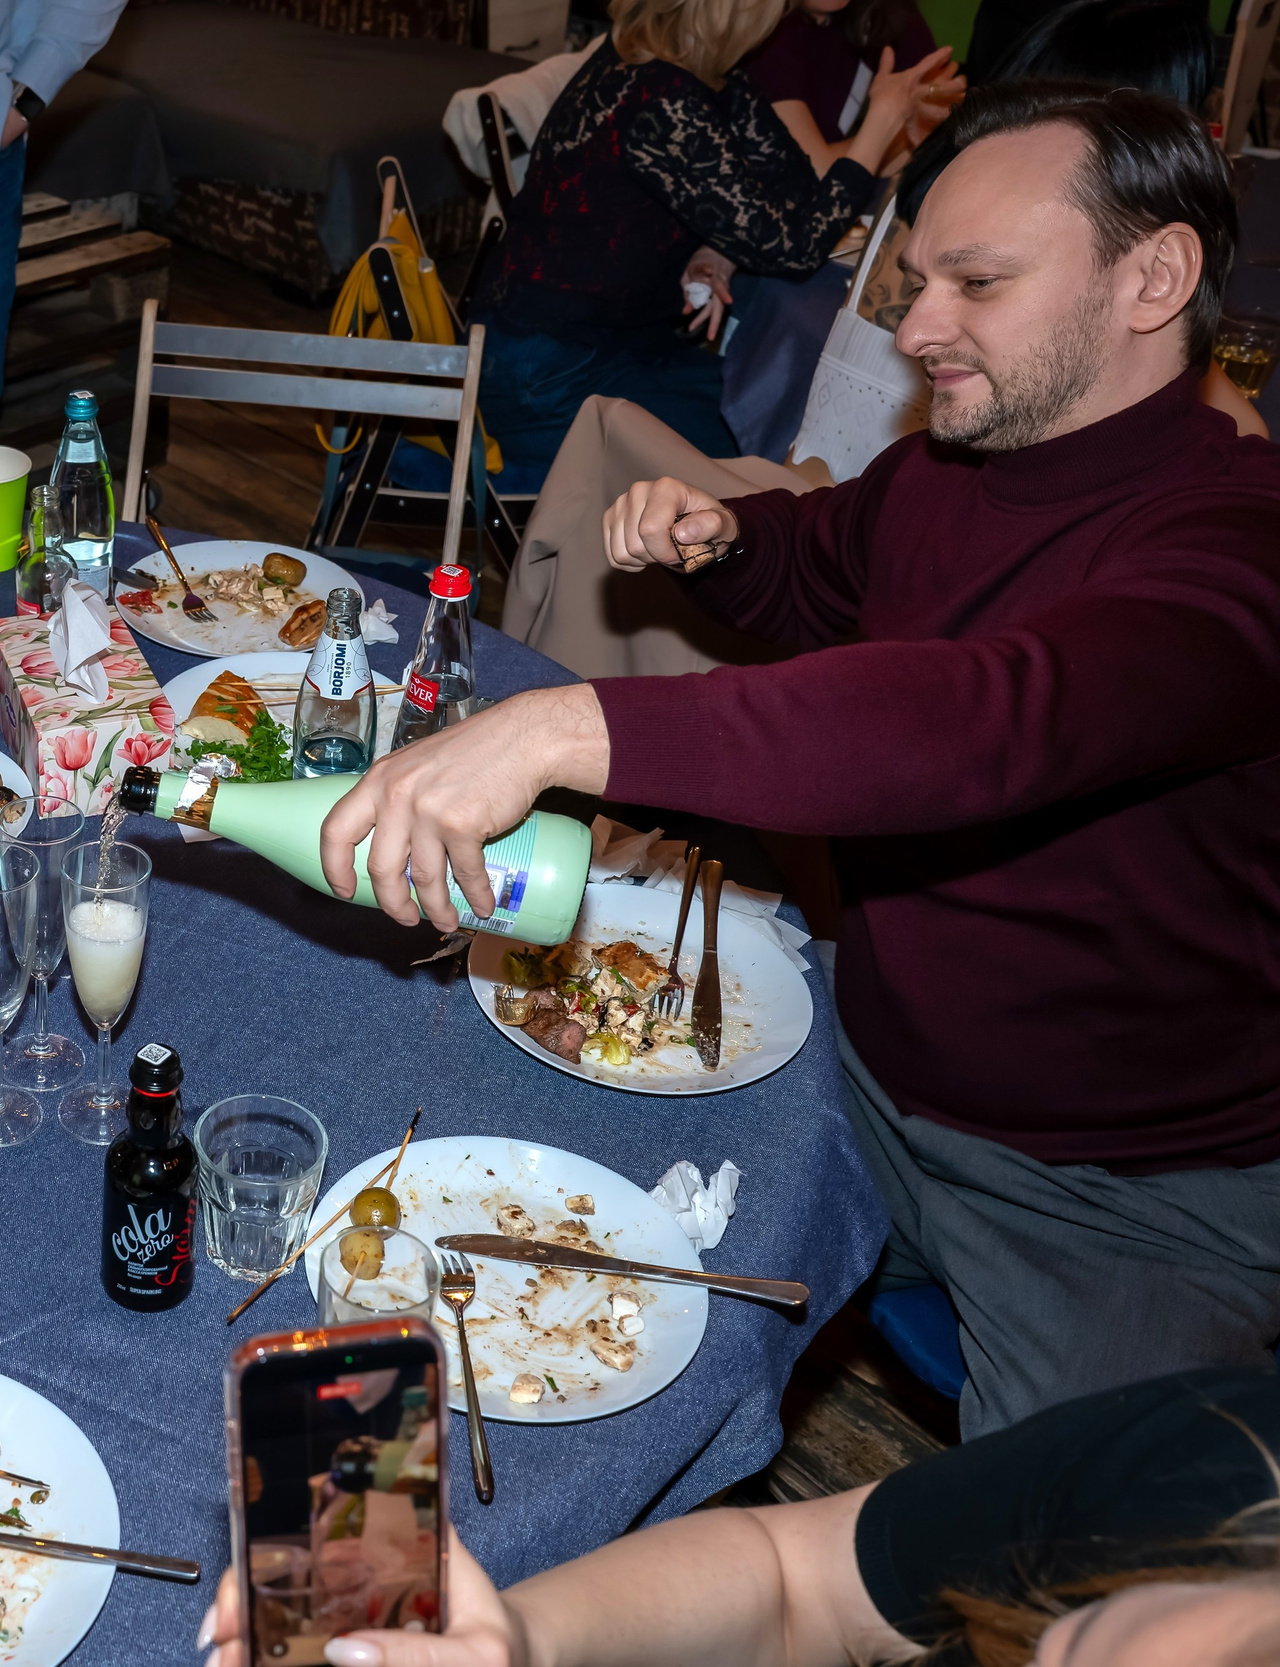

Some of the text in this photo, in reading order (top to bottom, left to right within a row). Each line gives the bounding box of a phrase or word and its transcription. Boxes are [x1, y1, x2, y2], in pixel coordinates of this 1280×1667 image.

[331, 643, 347, 696] BORJOMI
[409, 682, 433, 704] EVER
[112, 1204, 172, 1262] cola
[136, 1234, 174, 1264] zero
